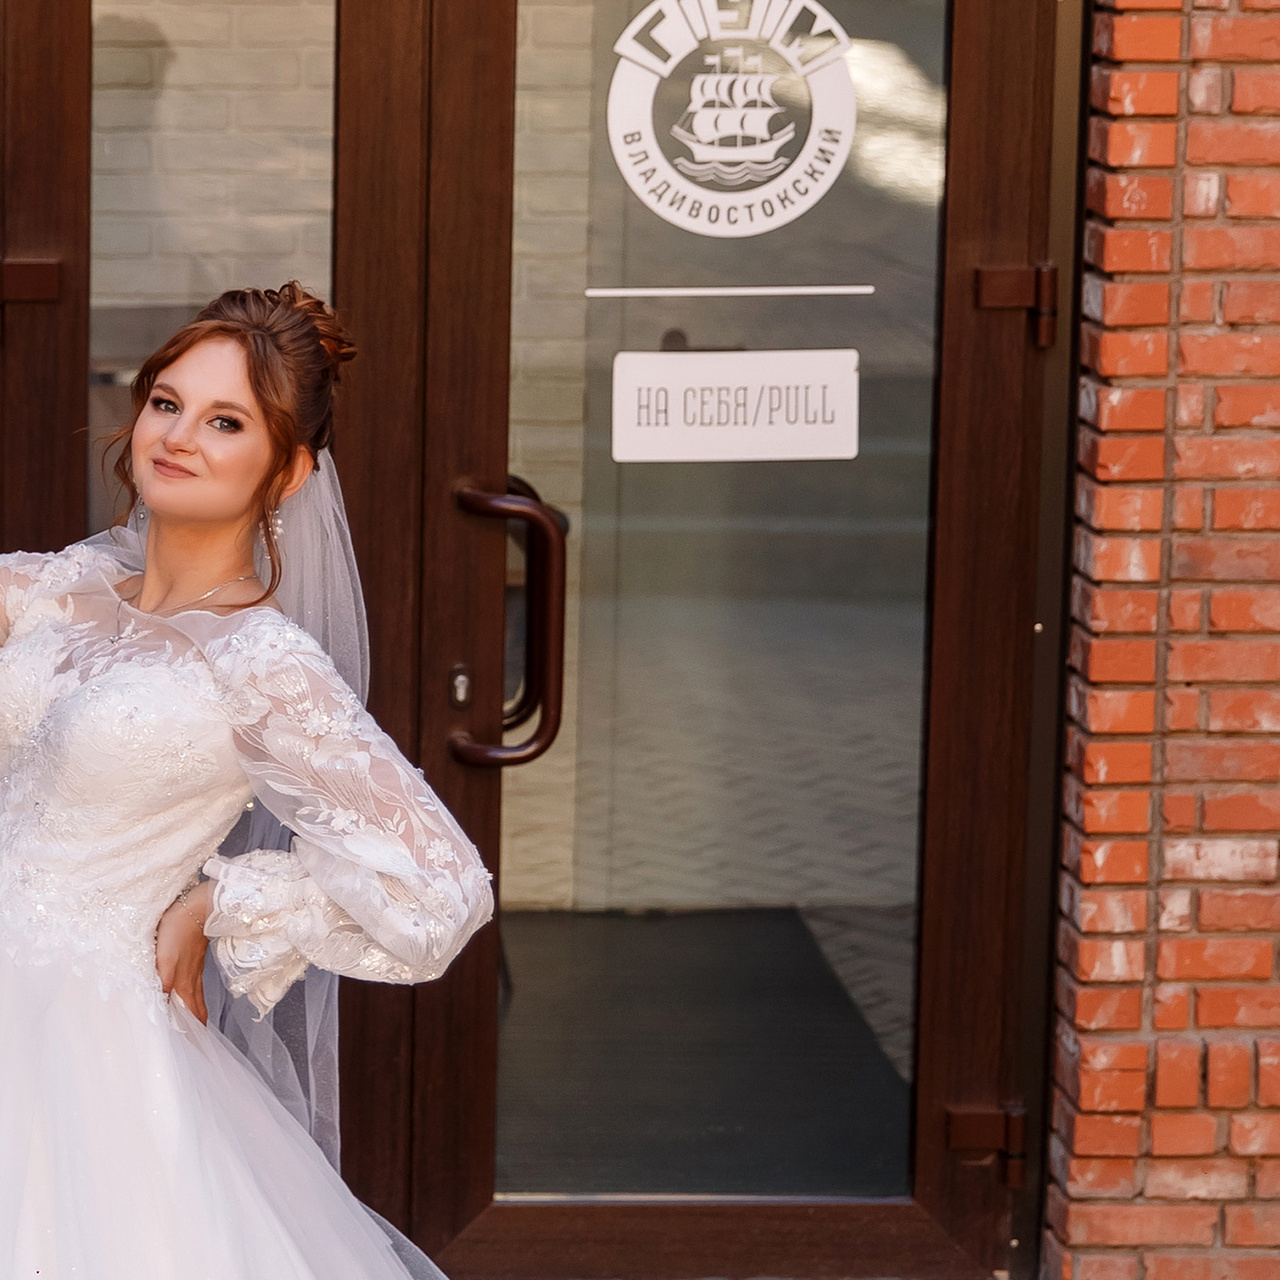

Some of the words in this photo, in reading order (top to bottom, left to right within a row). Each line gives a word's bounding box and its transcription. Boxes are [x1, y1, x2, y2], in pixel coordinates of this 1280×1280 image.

[622, 127, 842, 226] ВЛАДИВОСТОКСКИЙ
[636, 386, 670, 427] НА
[682, 384, 836, 427] СЕБЯ/PULL
